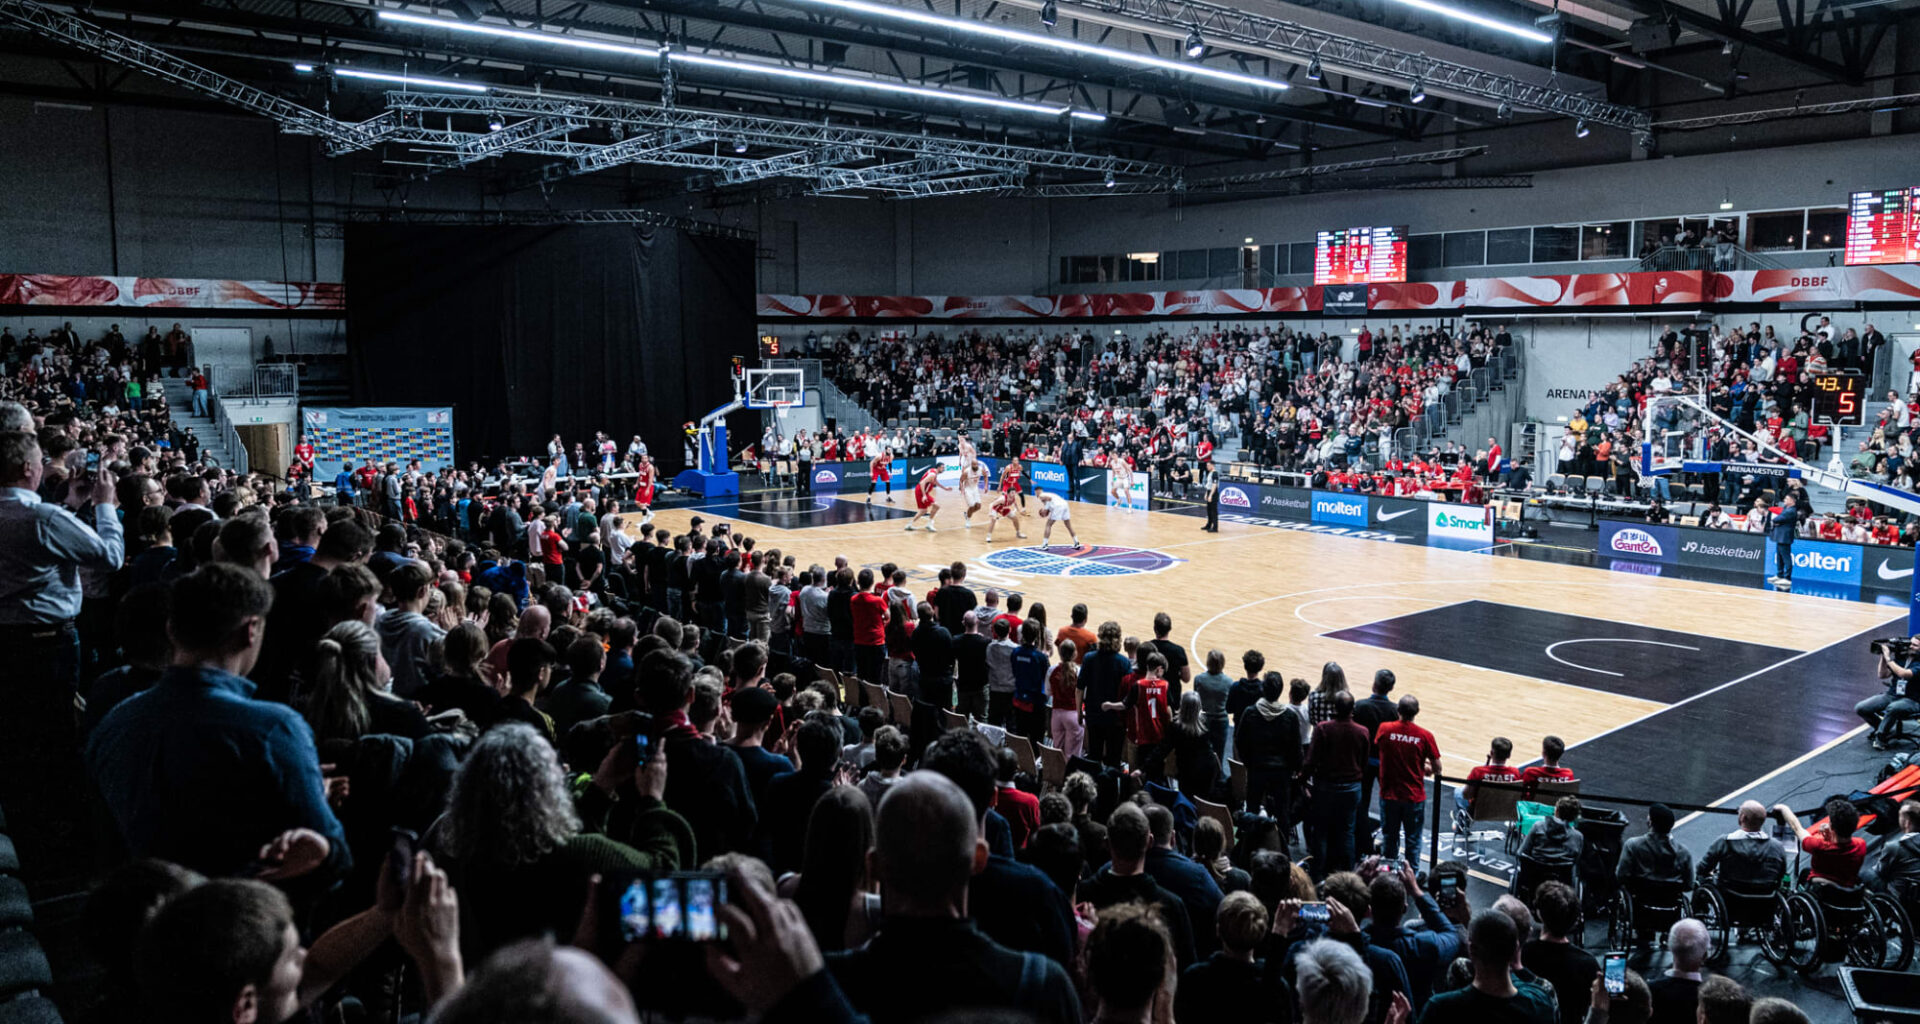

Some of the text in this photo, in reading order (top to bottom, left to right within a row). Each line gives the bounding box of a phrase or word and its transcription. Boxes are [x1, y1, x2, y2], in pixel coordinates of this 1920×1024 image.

[1791, 276, 1828, 287] DBBF
[168, 287, 200, 295] DBBF
[771, 344, 779, 354] 5
[1816, 377, 1853, 391] 43.1
[1838, 392, 1855, 413] 5
[1034, 470, 1065, 482] molten
[1726, 465, 1784, 476] ARENANÆSTVED
[1317, 501, 1361, 517] molten
[1450, 515, 1486, 531] Smart
[1681, 541, 1761, 560] J9.basketball
[1148, 698, 1156, 718] 1
[1390, 733, 1420, 744] STAFF
[1483, 773, 1515, 782] STAFF
